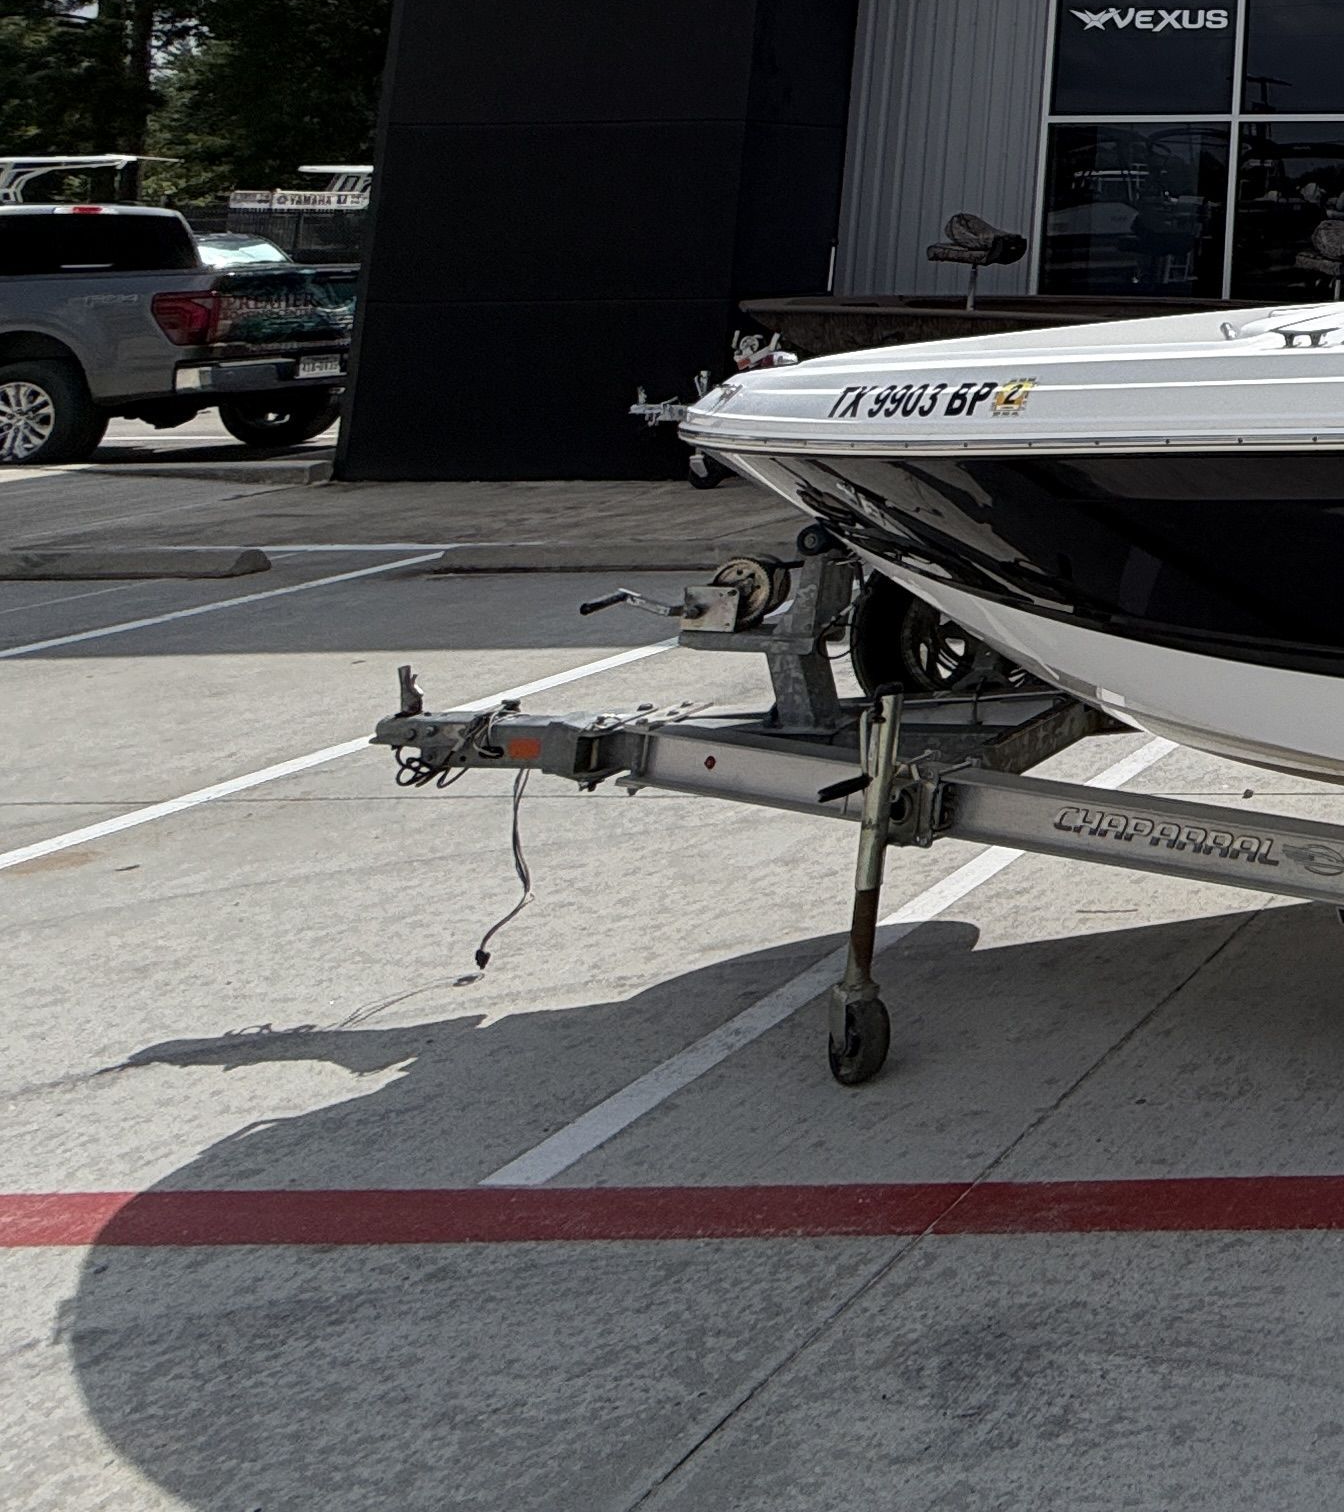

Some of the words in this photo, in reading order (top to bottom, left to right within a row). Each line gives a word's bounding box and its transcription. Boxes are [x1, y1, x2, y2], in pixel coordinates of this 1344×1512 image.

[827, 385, 879, 418] TX
[867, 382, 949, 418] 9903
[944, 382, 998, 416] BP
[1053, 806, 1279, 866] CHAPARRAL
